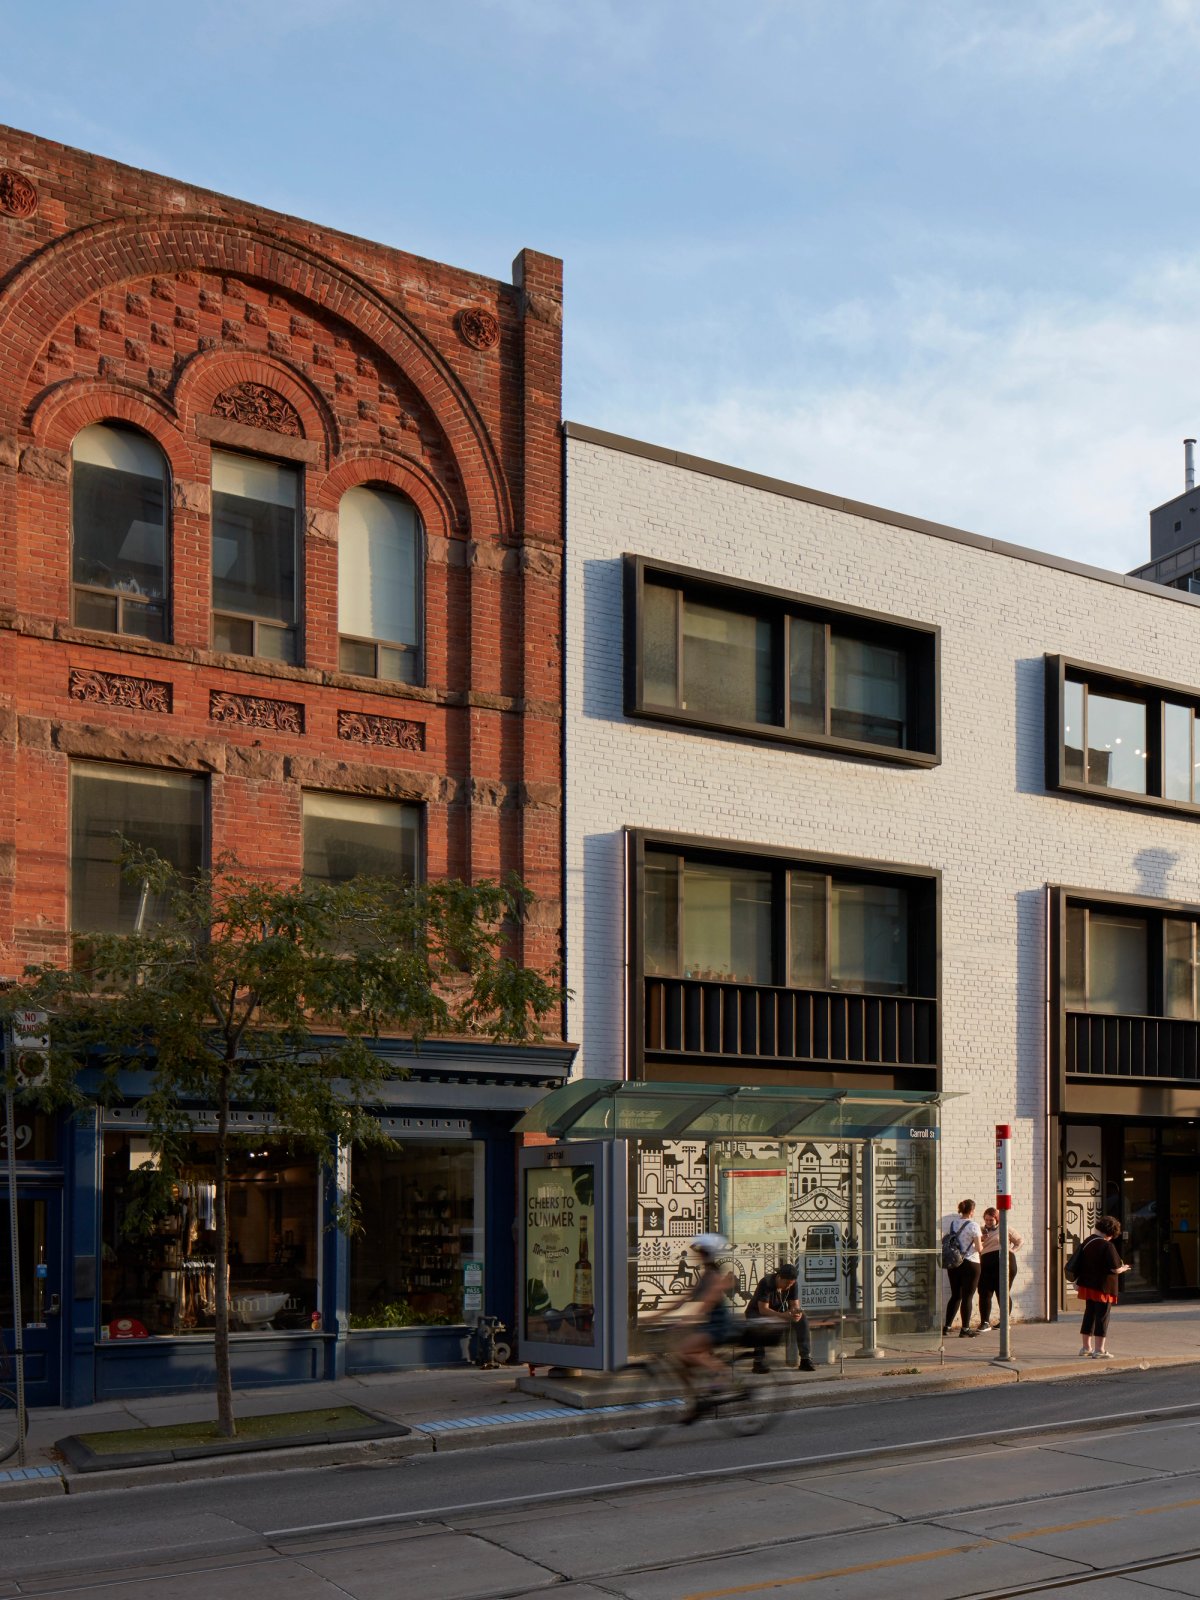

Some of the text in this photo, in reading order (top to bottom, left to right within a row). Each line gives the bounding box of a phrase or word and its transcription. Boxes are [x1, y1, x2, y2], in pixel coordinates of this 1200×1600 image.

[24, 1012, 37, 1022] NO
[910, 1129, 928, 1138] Carroll
[547, 1151, 564, 1159] astral
[528, 1196, 575, 1209] CHEERS TO
[528, 1211, 575, 1227] SUMMER
[802, 1287, 840, 1296] BLACKBIRD
[802, 1296, 840, 1305] BAKING CO.
